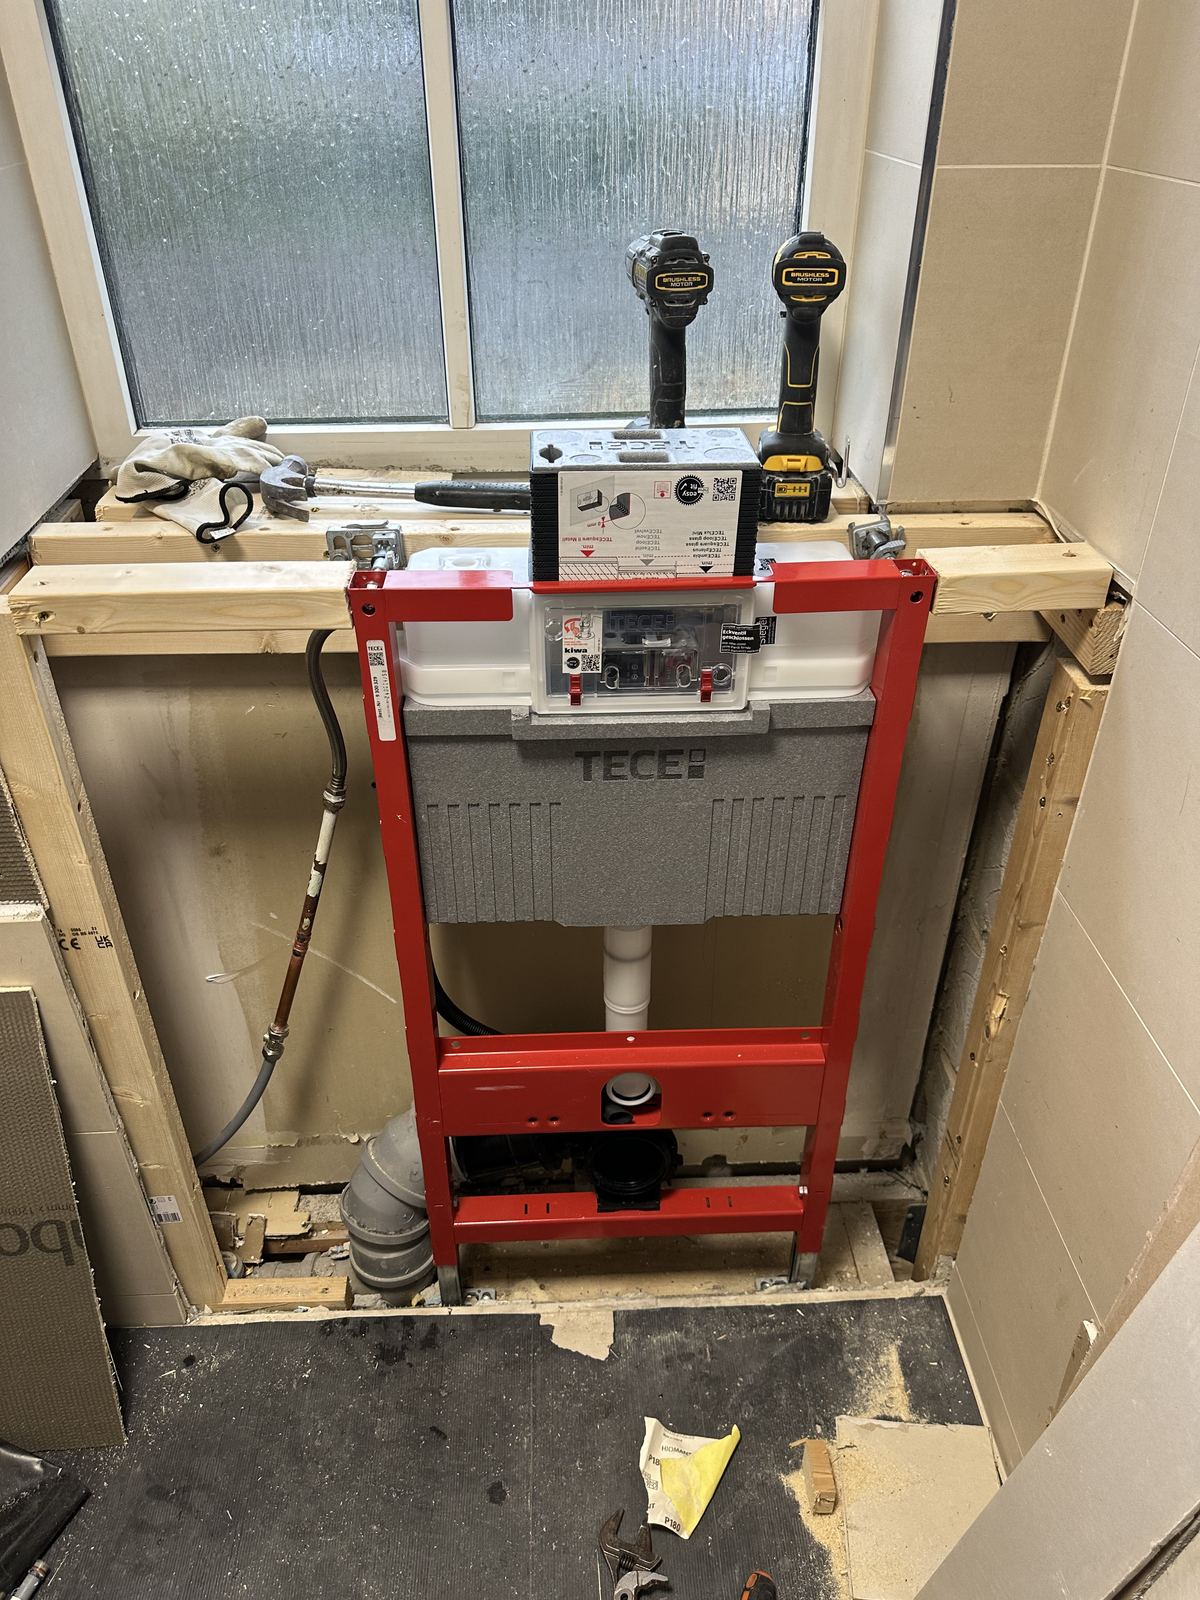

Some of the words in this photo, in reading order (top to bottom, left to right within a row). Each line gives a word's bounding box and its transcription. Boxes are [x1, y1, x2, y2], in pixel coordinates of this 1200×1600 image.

[575, 749, 684, 781] TECE
[648, 1454, 661, 1466] P18
[664, 1516, 681, 1532] P180
